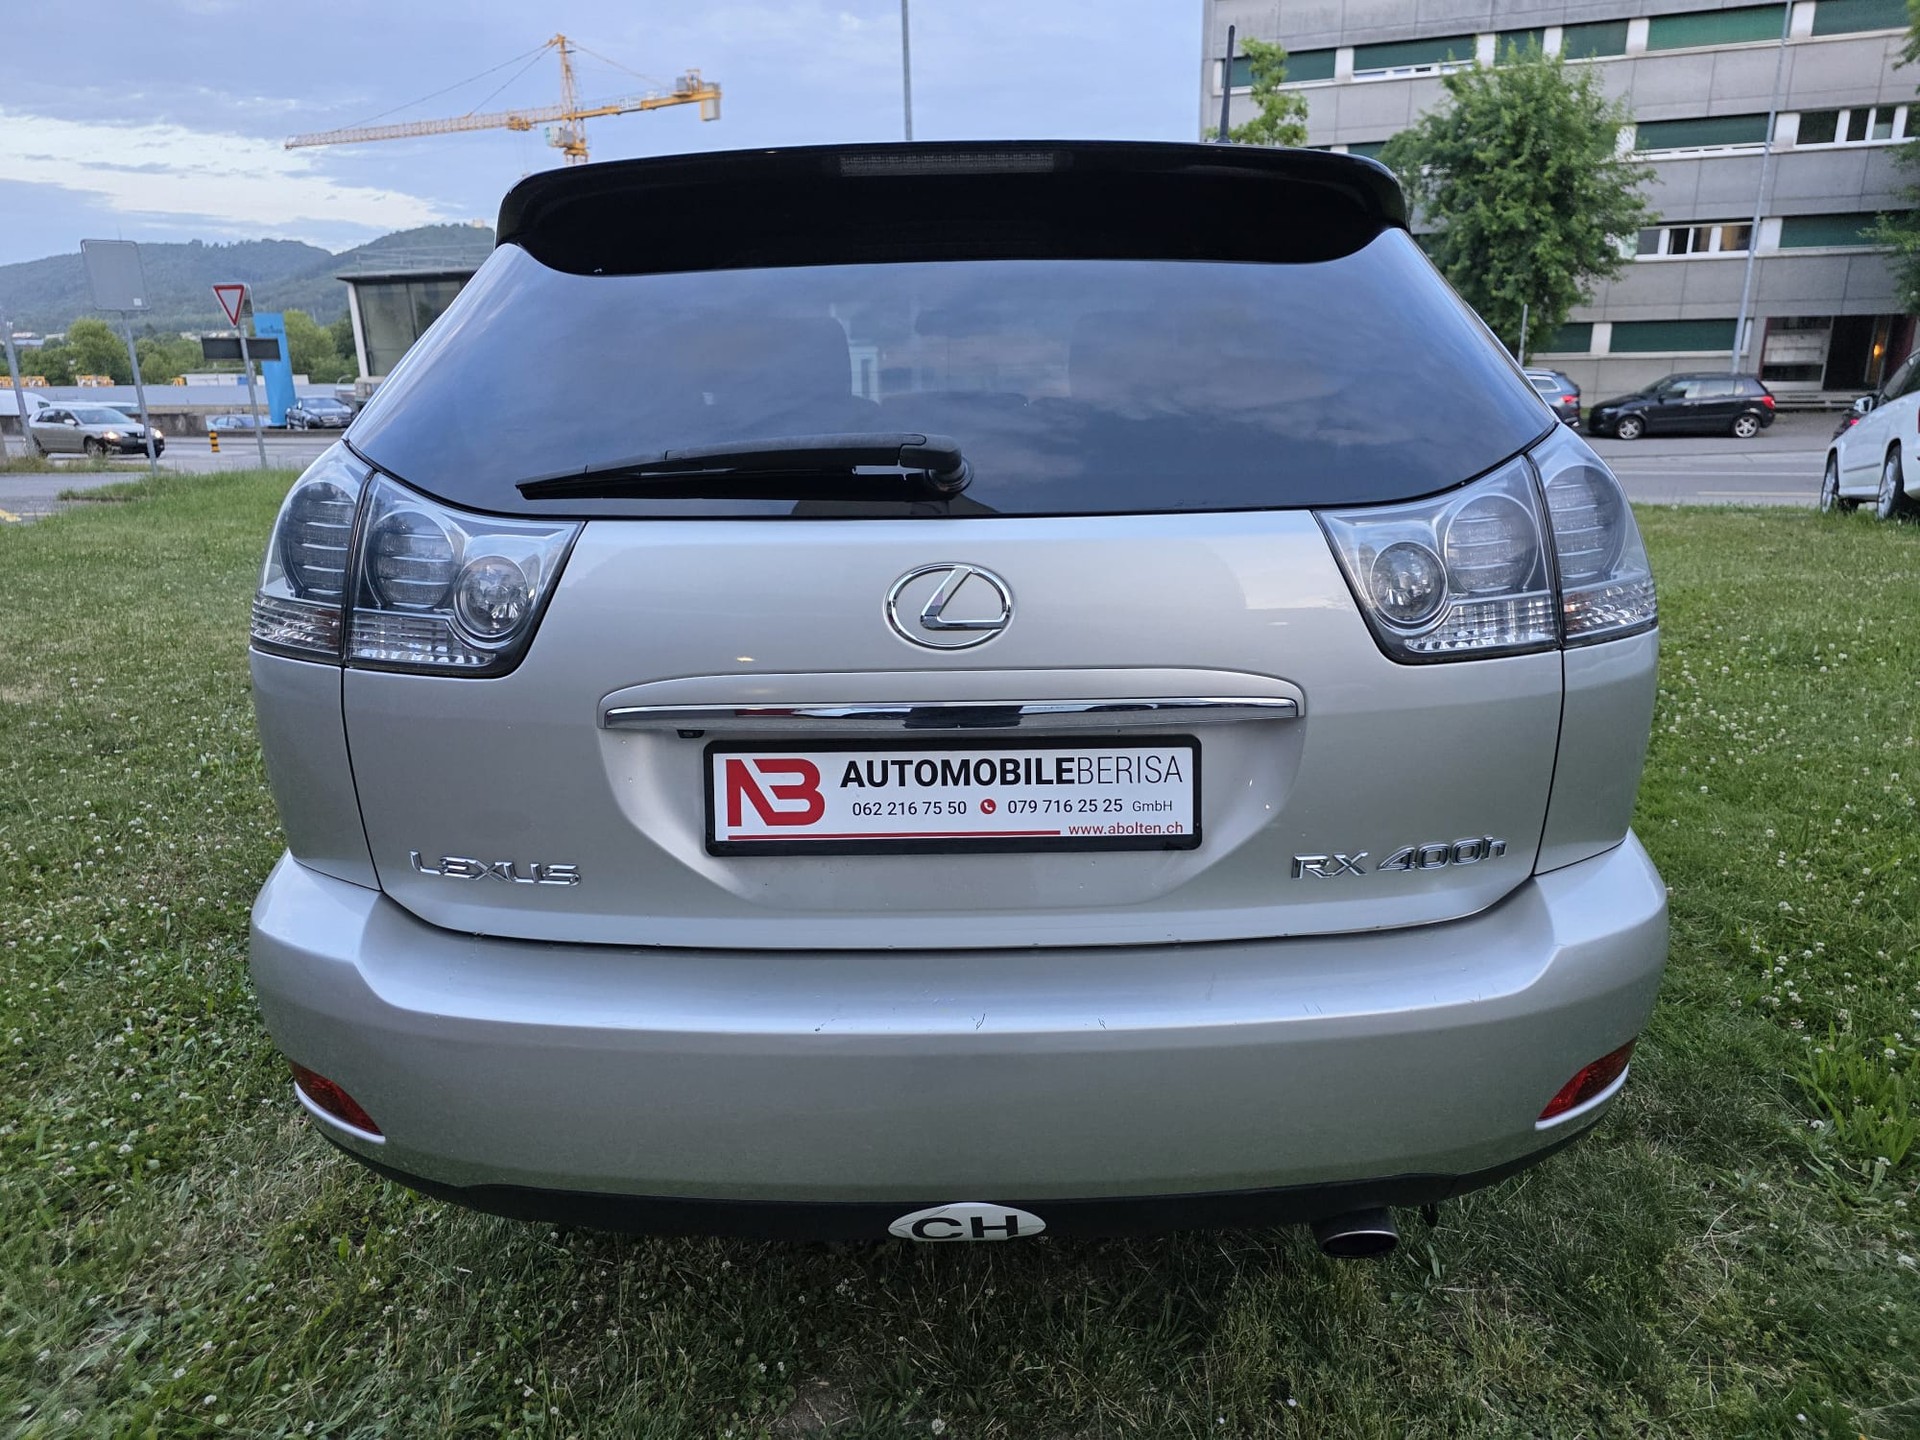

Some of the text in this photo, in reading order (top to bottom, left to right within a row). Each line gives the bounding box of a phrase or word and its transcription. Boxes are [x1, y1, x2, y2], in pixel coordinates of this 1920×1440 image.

[852, 800, 968, 816] 062 216 75 50
[1007, 798, 1173, 814] 079 716 25 25 GmbH
[1068, 821, 1184, 836] www.abolten.ch
[1290, 834, 1508, 879] RX 400h
[409, 850, 582, 887] LEXUS
[911, 1214, 1019, 1240] CH
